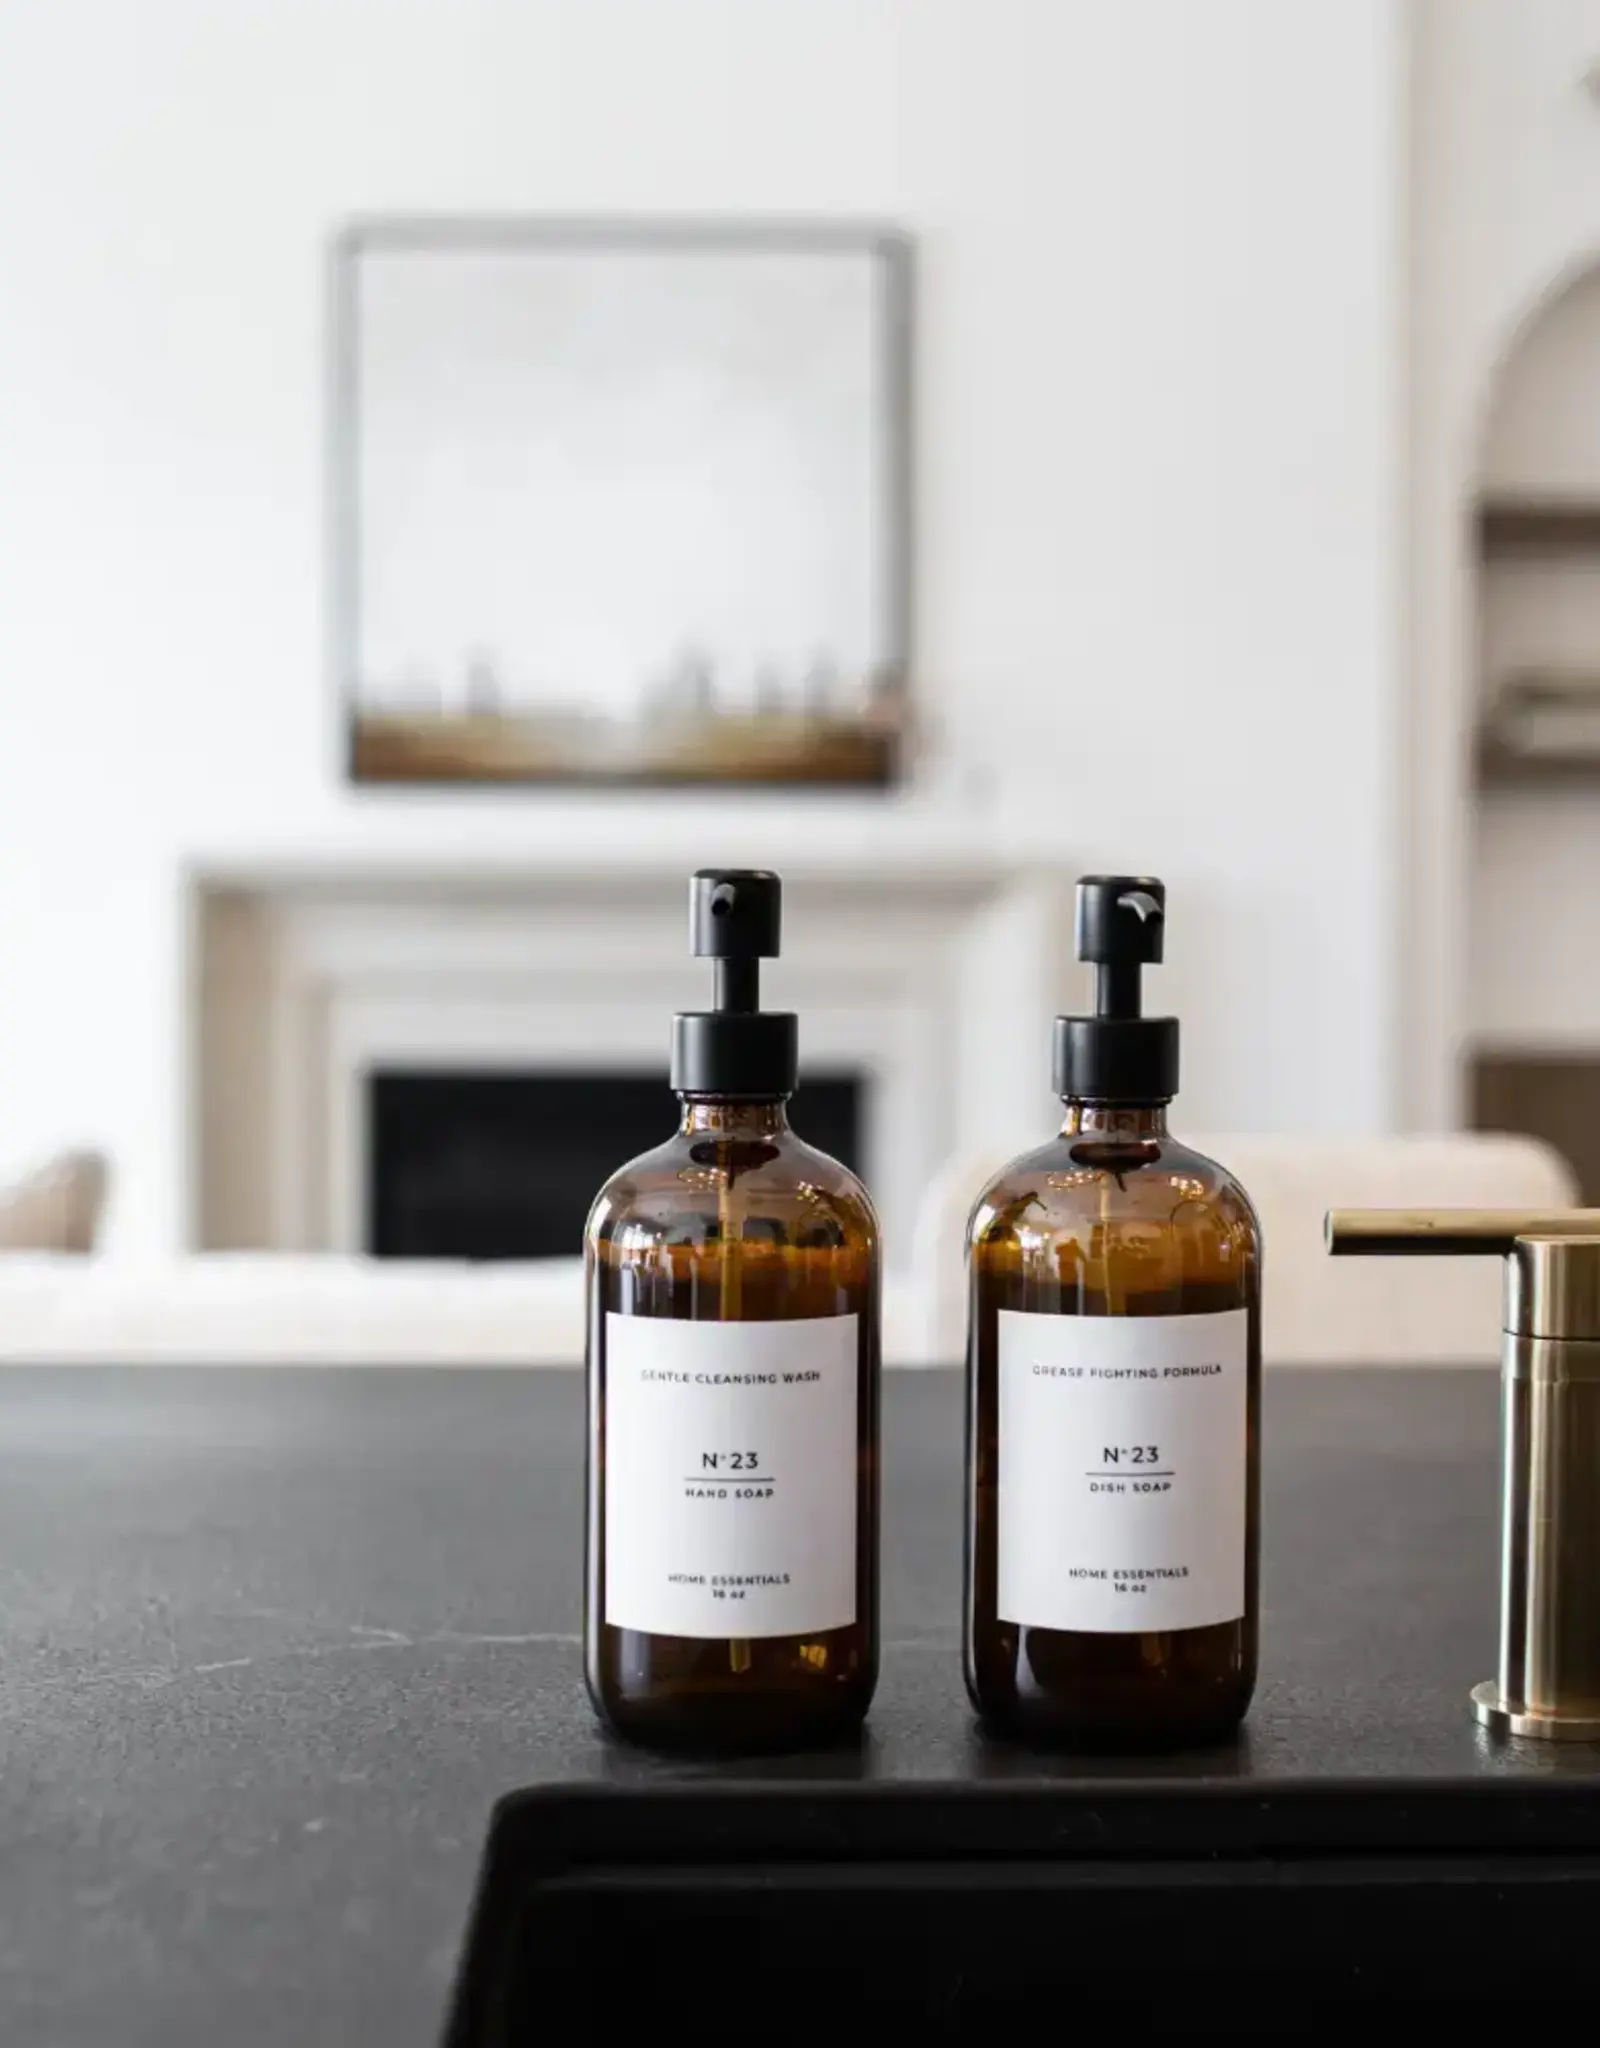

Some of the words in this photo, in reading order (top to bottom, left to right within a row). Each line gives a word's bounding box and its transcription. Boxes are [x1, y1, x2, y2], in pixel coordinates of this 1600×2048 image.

[641, 1369, 690, 1384] GENTLE
[695, 1371, 778, 1386] CLEANSING
[782, 1370, 822, 1385] WASH
[1033, 1364, 1084, 1378] GREASE
[1090, 1367, 1158, 1380] FIGHTING
[1164, 1364, 1223, 1379] FORMULA
[685, 1487, 728, 1499] HAND
[735, 1487, 775, 1500] SOAP
[1089, 1482, 1126, 1494] DISH
[1132, 1482, 1172, 1494] SOAP
[668, 1573, 706, 1585] HOME
[711, 1572, 791, 1586] ESSENTIALS
[1069, 1567, 1108, 1580] HOME
[1113, 1566, 1189, 1580] ESSENTIALS
[712, 1588, 726, 1600] 16
[729, 1590, 746, 1600] oz
[1114, 1582, 1128, 1594] 16
[1131, 1583, 1148, 1594] oz
